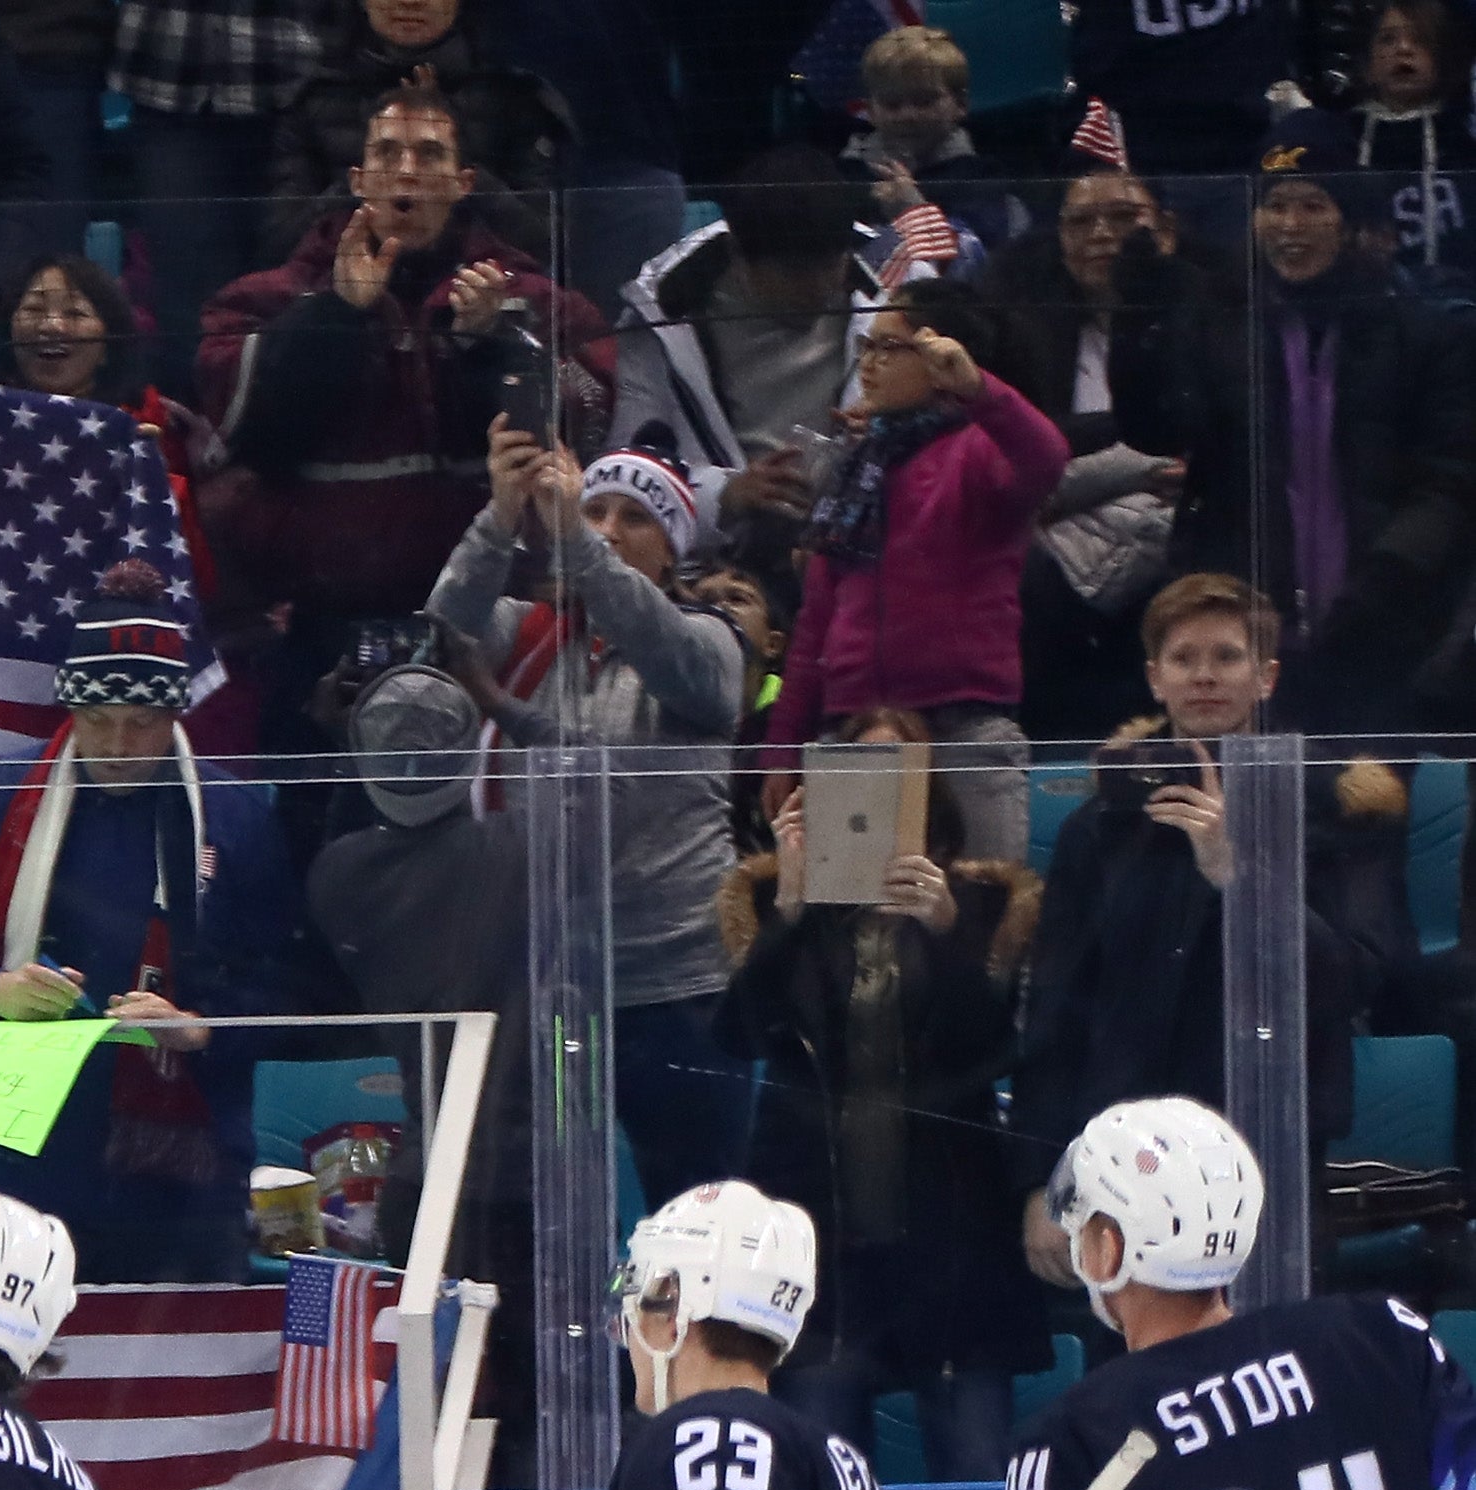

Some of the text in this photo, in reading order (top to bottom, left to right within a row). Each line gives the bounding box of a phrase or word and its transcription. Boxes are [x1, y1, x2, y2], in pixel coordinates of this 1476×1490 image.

[1203, 1230, 1237, 1257] 94
[2, 1273, 37, 1306] 97
[771, 1280, 804, 1313] 23
